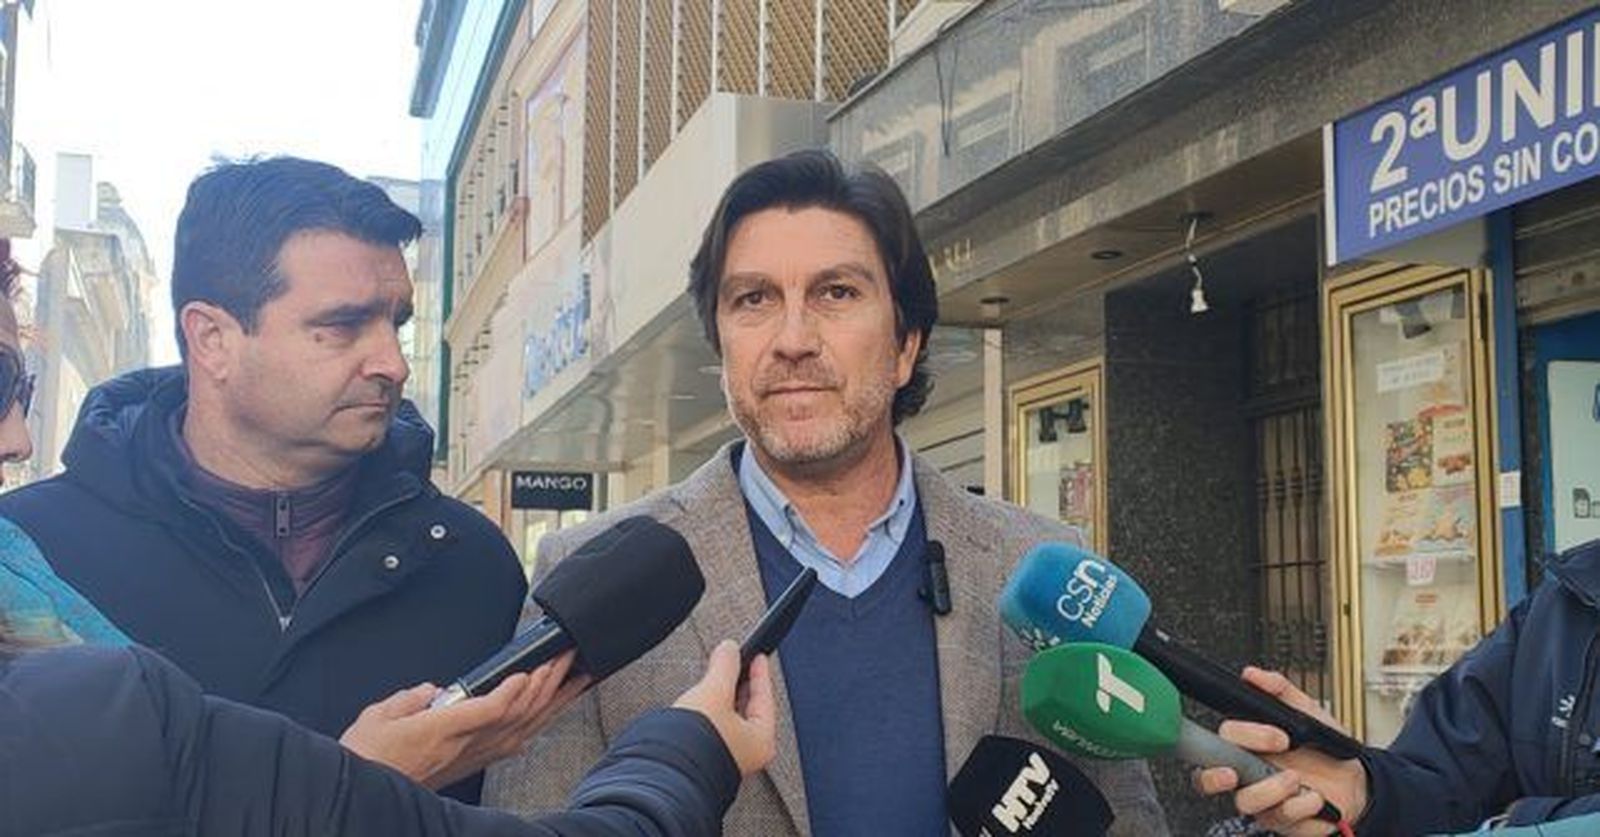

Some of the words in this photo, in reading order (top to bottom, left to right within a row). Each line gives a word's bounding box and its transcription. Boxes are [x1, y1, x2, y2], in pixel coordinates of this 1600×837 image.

[1369, 164, 1485, 239] PRECIOS
[1493, 141, 1542, 194] SIN
[514, 474, 588, 490] MANGO
[991, 751, 1051, 833] HTV
